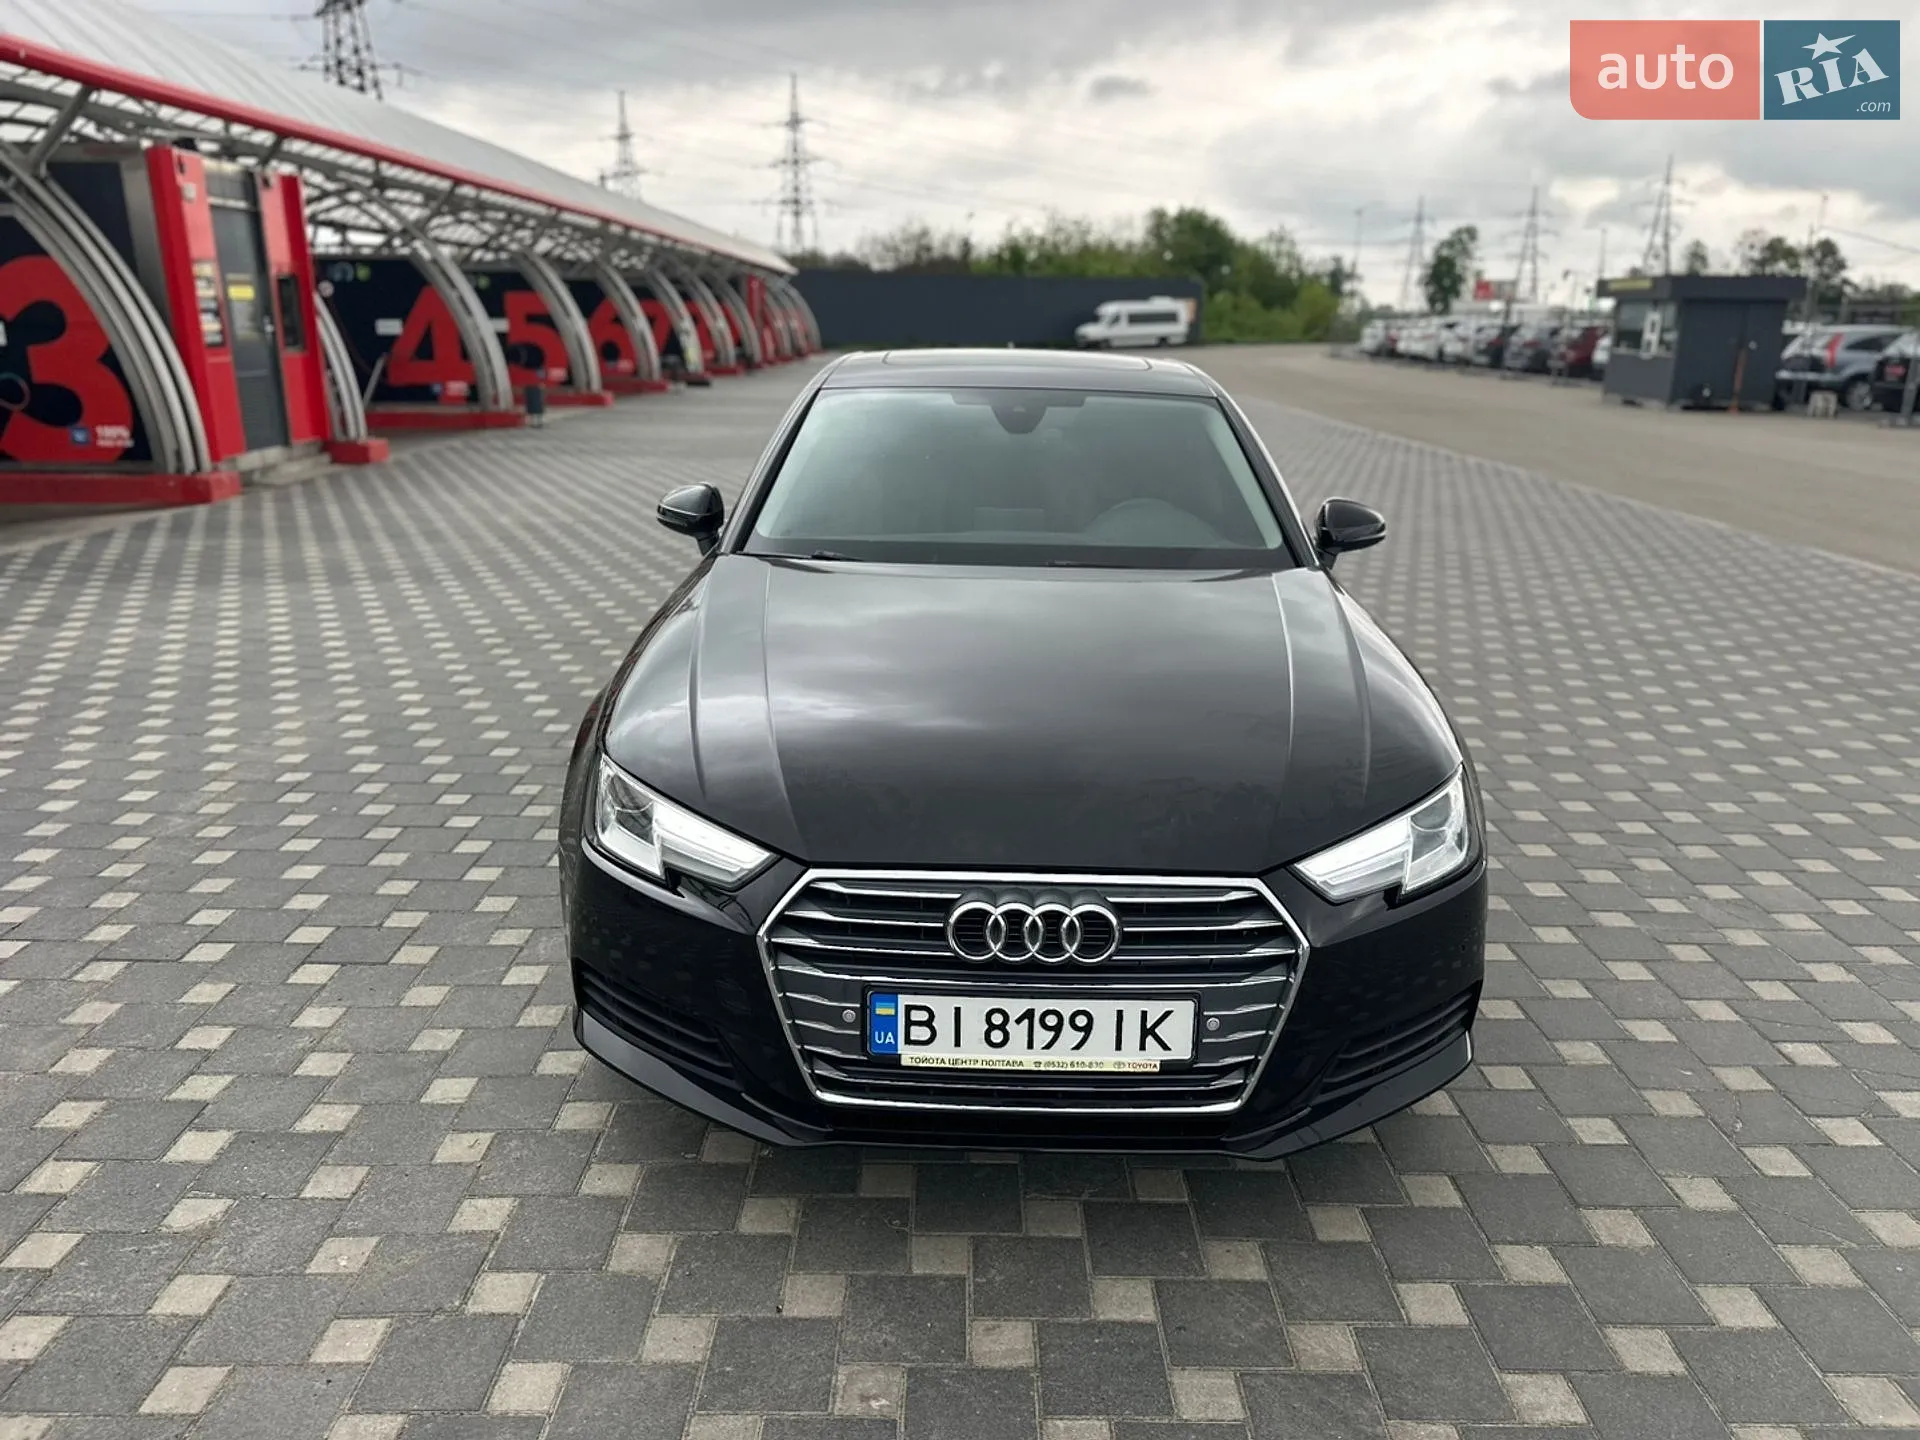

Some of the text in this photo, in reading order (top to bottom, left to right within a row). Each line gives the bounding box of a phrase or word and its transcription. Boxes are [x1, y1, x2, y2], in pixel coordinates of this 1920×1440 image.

[0, 254, 133, 464] 3
[387, 284, 478, 387] 4
[503, 289, 569, 388] 5
[587, 297, 638, 378] 6
[875, 1031, 896, 1045] UA
[903, 1004, 1175, 1052] BI 8199 IK
[909, 1056, 946, 1066] ТОЙОТА
[948, 1057, 979, 1067] ЦЕНТР
[1127, 1061, 1158, 1070] TOYOTA
